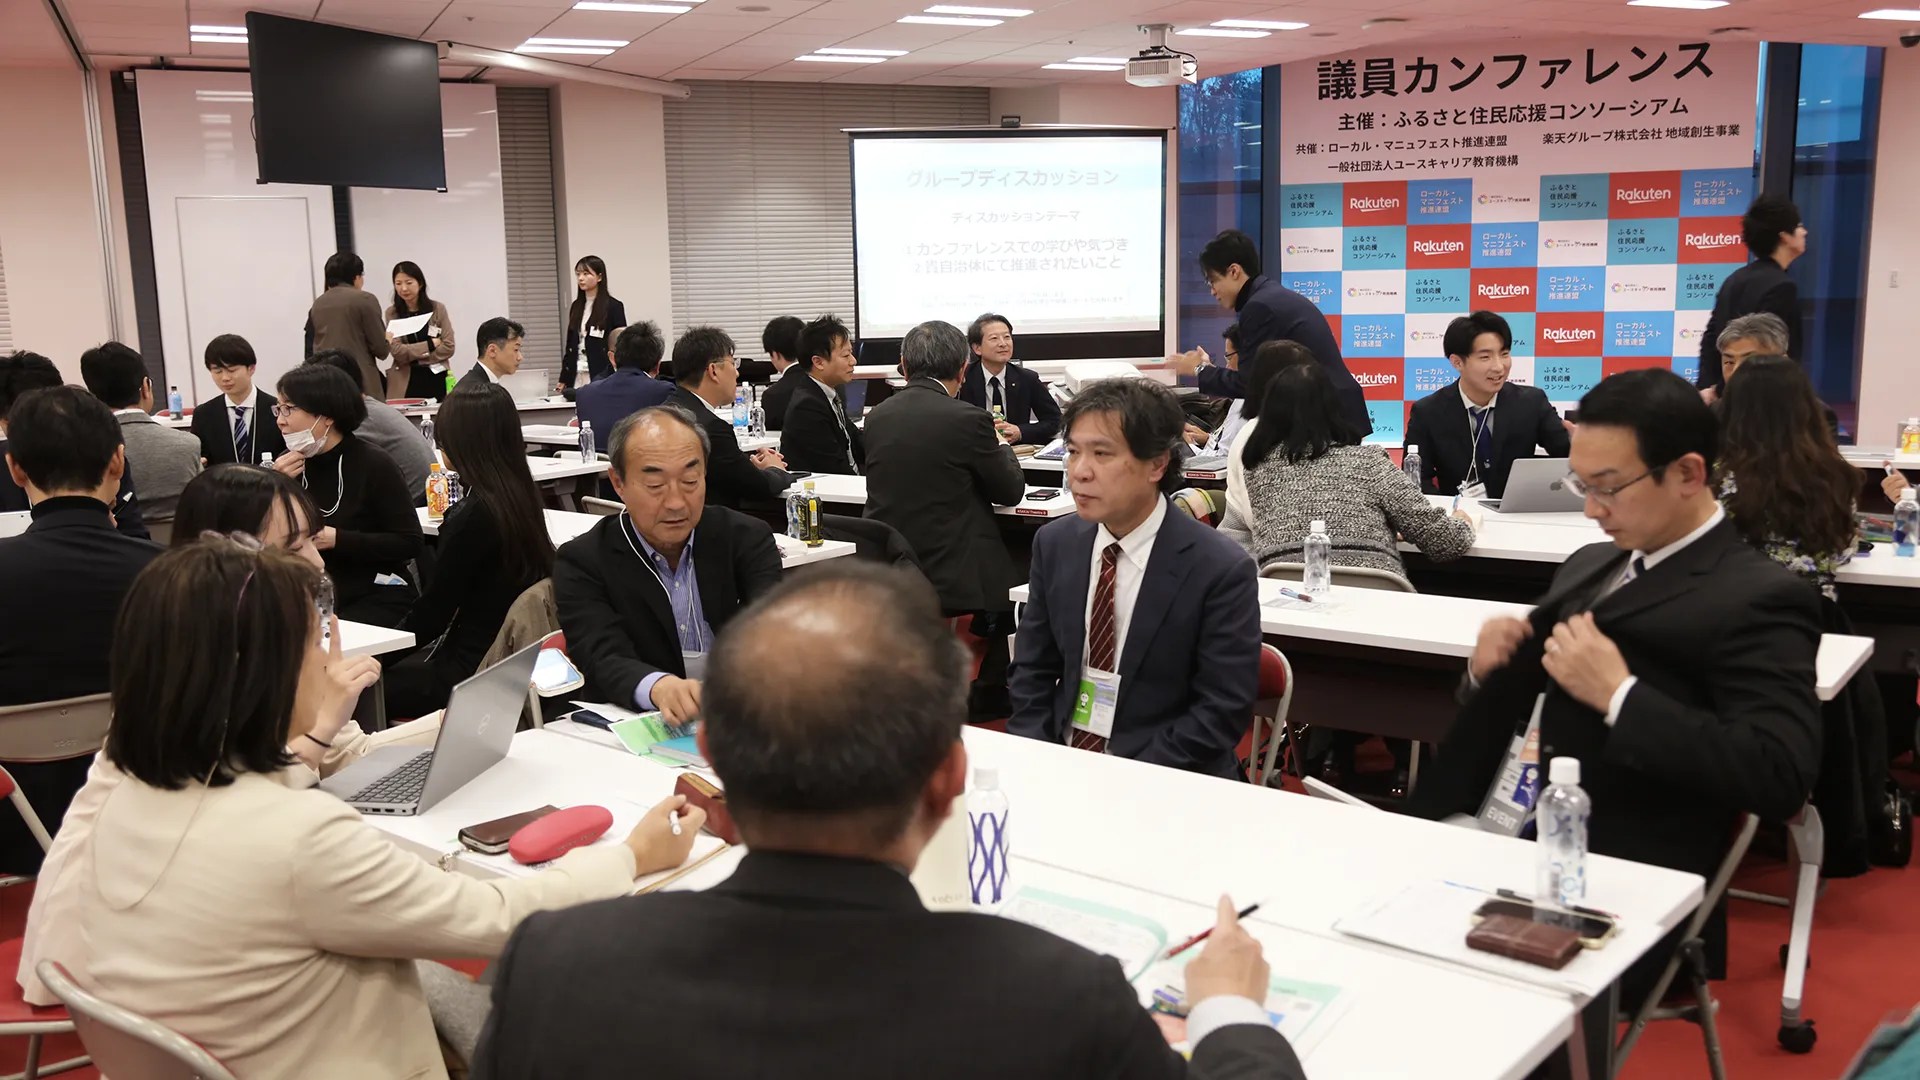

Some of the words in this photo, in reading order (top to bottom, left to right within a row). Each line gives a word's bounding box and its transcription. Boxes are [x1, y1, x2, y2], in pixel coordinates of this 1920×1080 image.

[1317, 42, 1713, 101] 議員カンファレンス
[1338, 97, 1689, 131] 主催：ふるさと住民応援コンソーシアム
[1542, 128, 1663, 145] 楽天グループ株式会社
[1665, 123, 1740, 140] 地域創生事業
[1296, 134, 1508, 155] 共催：ローカル・マニュフェスト推進連盟
[1328, 154, 1519, 173] 一般社団法人ユースキャリア教育機構
[1616, 188, 1671, 200] Rakuten
[1350, 197, 1399, 209] Rakuten
[1414, 240, 1463, 252] Rakuten
[1686, 233, 1741, 245] Rakuten
[1478, 284, 1529, 295] Rakuten
[1544, 328, 1595, 340] Rakuten
[1486, 806, 1519, 830] EVENT
